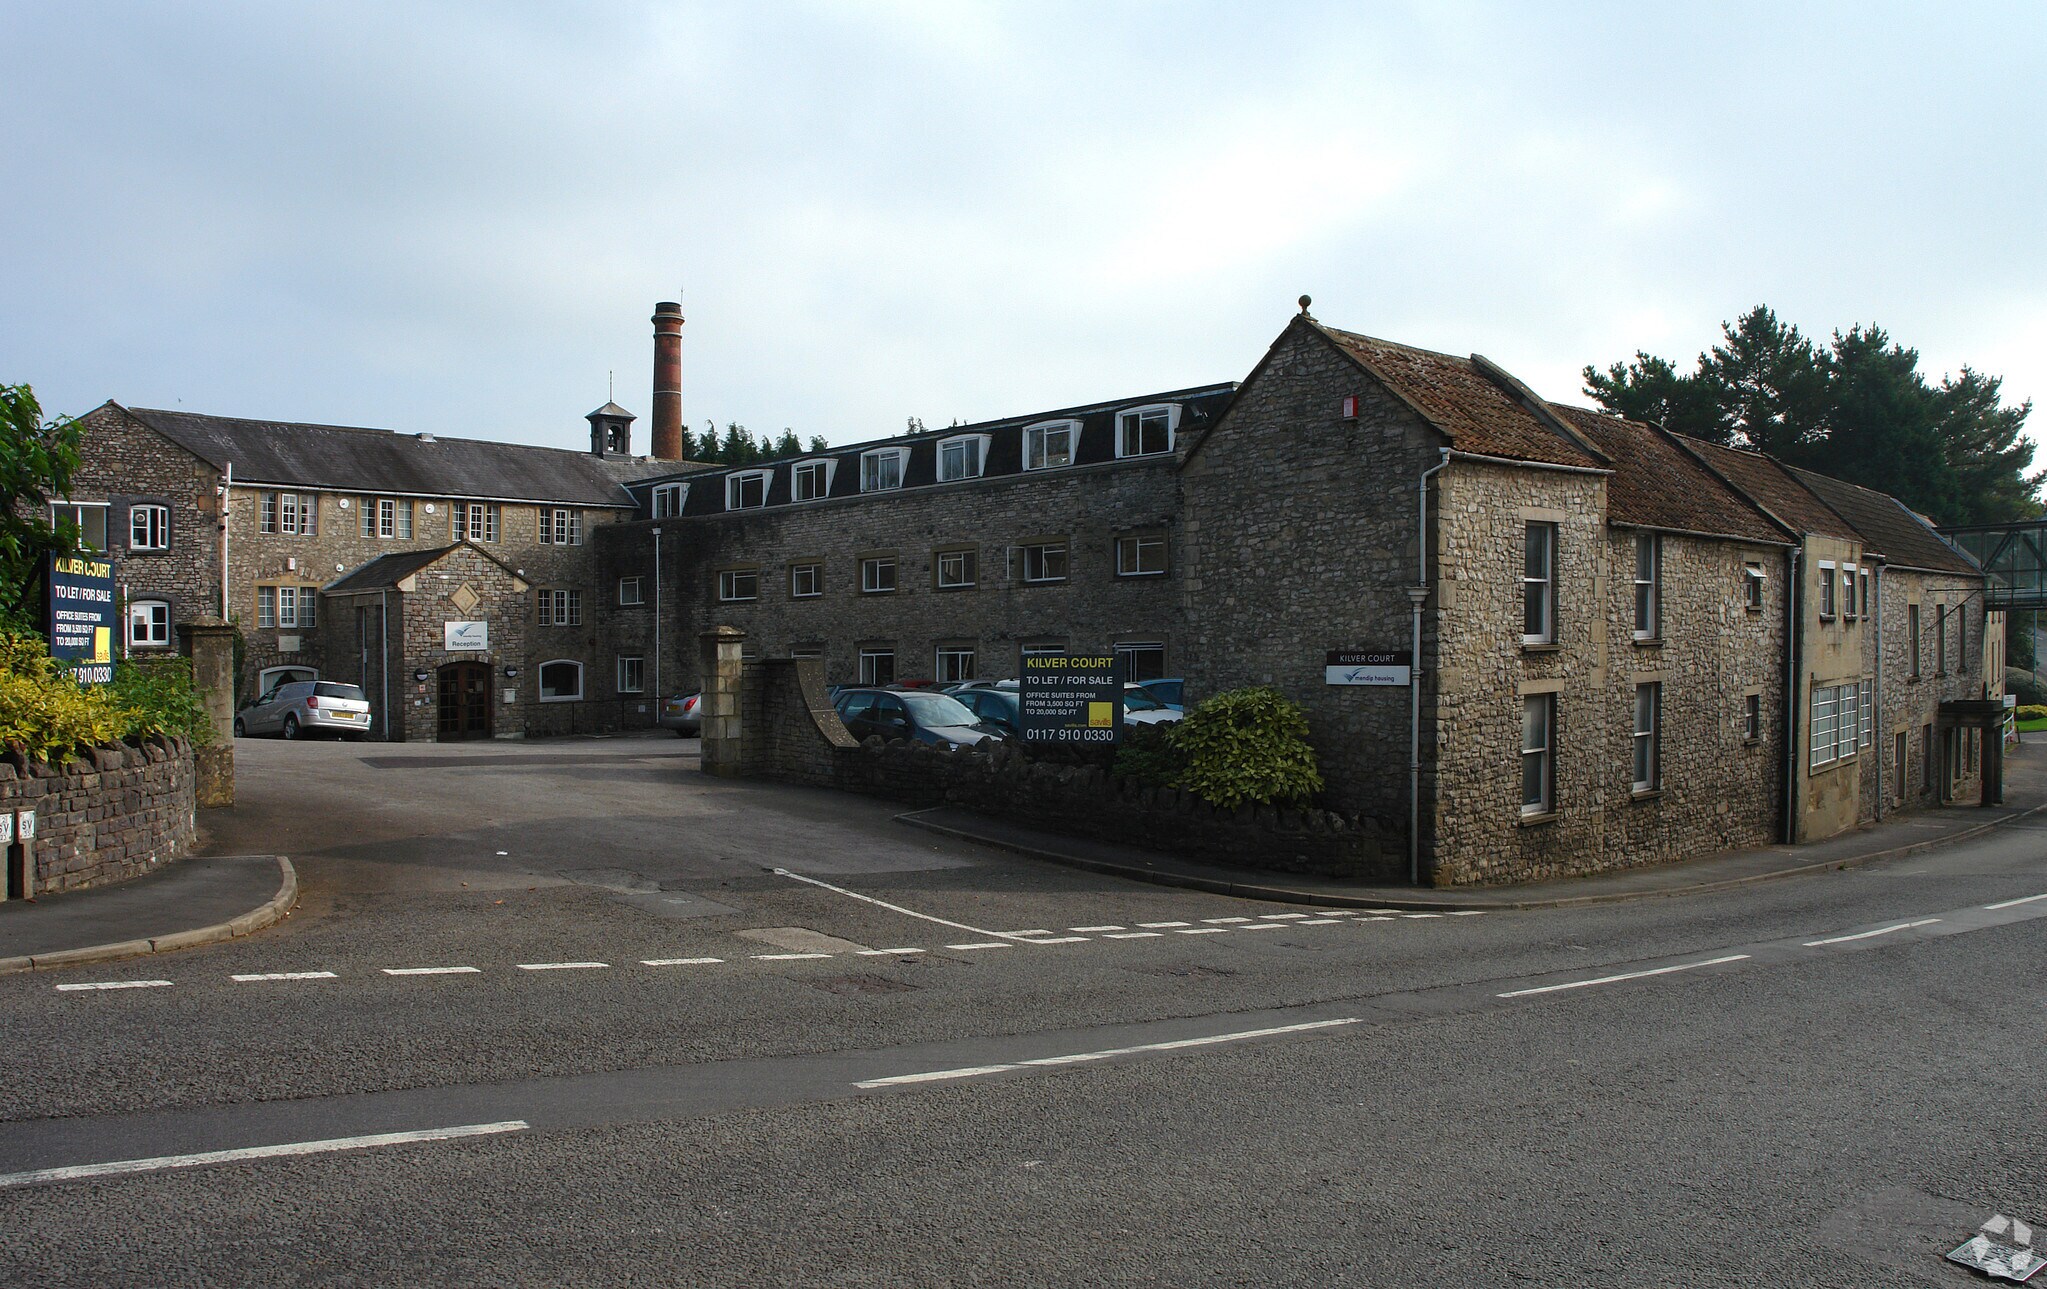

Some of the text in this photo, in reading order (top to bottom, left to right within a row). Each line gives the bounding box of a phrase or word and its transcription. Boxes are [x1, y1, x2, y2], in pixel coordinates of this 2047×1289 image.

[55, 557, 111, 578] KILVER COURT
[55, 585, 66, 599] TO
[67, 586, 79, 599] LET
[82, 588, 96, 601] FOR
[96, 589, 111, 602] SALE
[56, 610, 102, 622] OFFICE SUITES FROM
[56, 623, 71, 633] FROM
[88, 625, 94, 634] FT
[56, 636, 64, 646] TO
[84, 637, 90, 646] FT
[1027, 658, 1113, 668] KILVER COURT
[78, 667, 92, 684] 910
[93, 666, 112, 683] 0330
[1374, 675, 1395, 683] housing
[1026, 676, 1113, 685] TO LET / FOR SALE
[1090, 718, 1111, 726] savills
[1026, 729, 1114, 741] 0117 910 0330
[22, 820, 32, 830] SV
